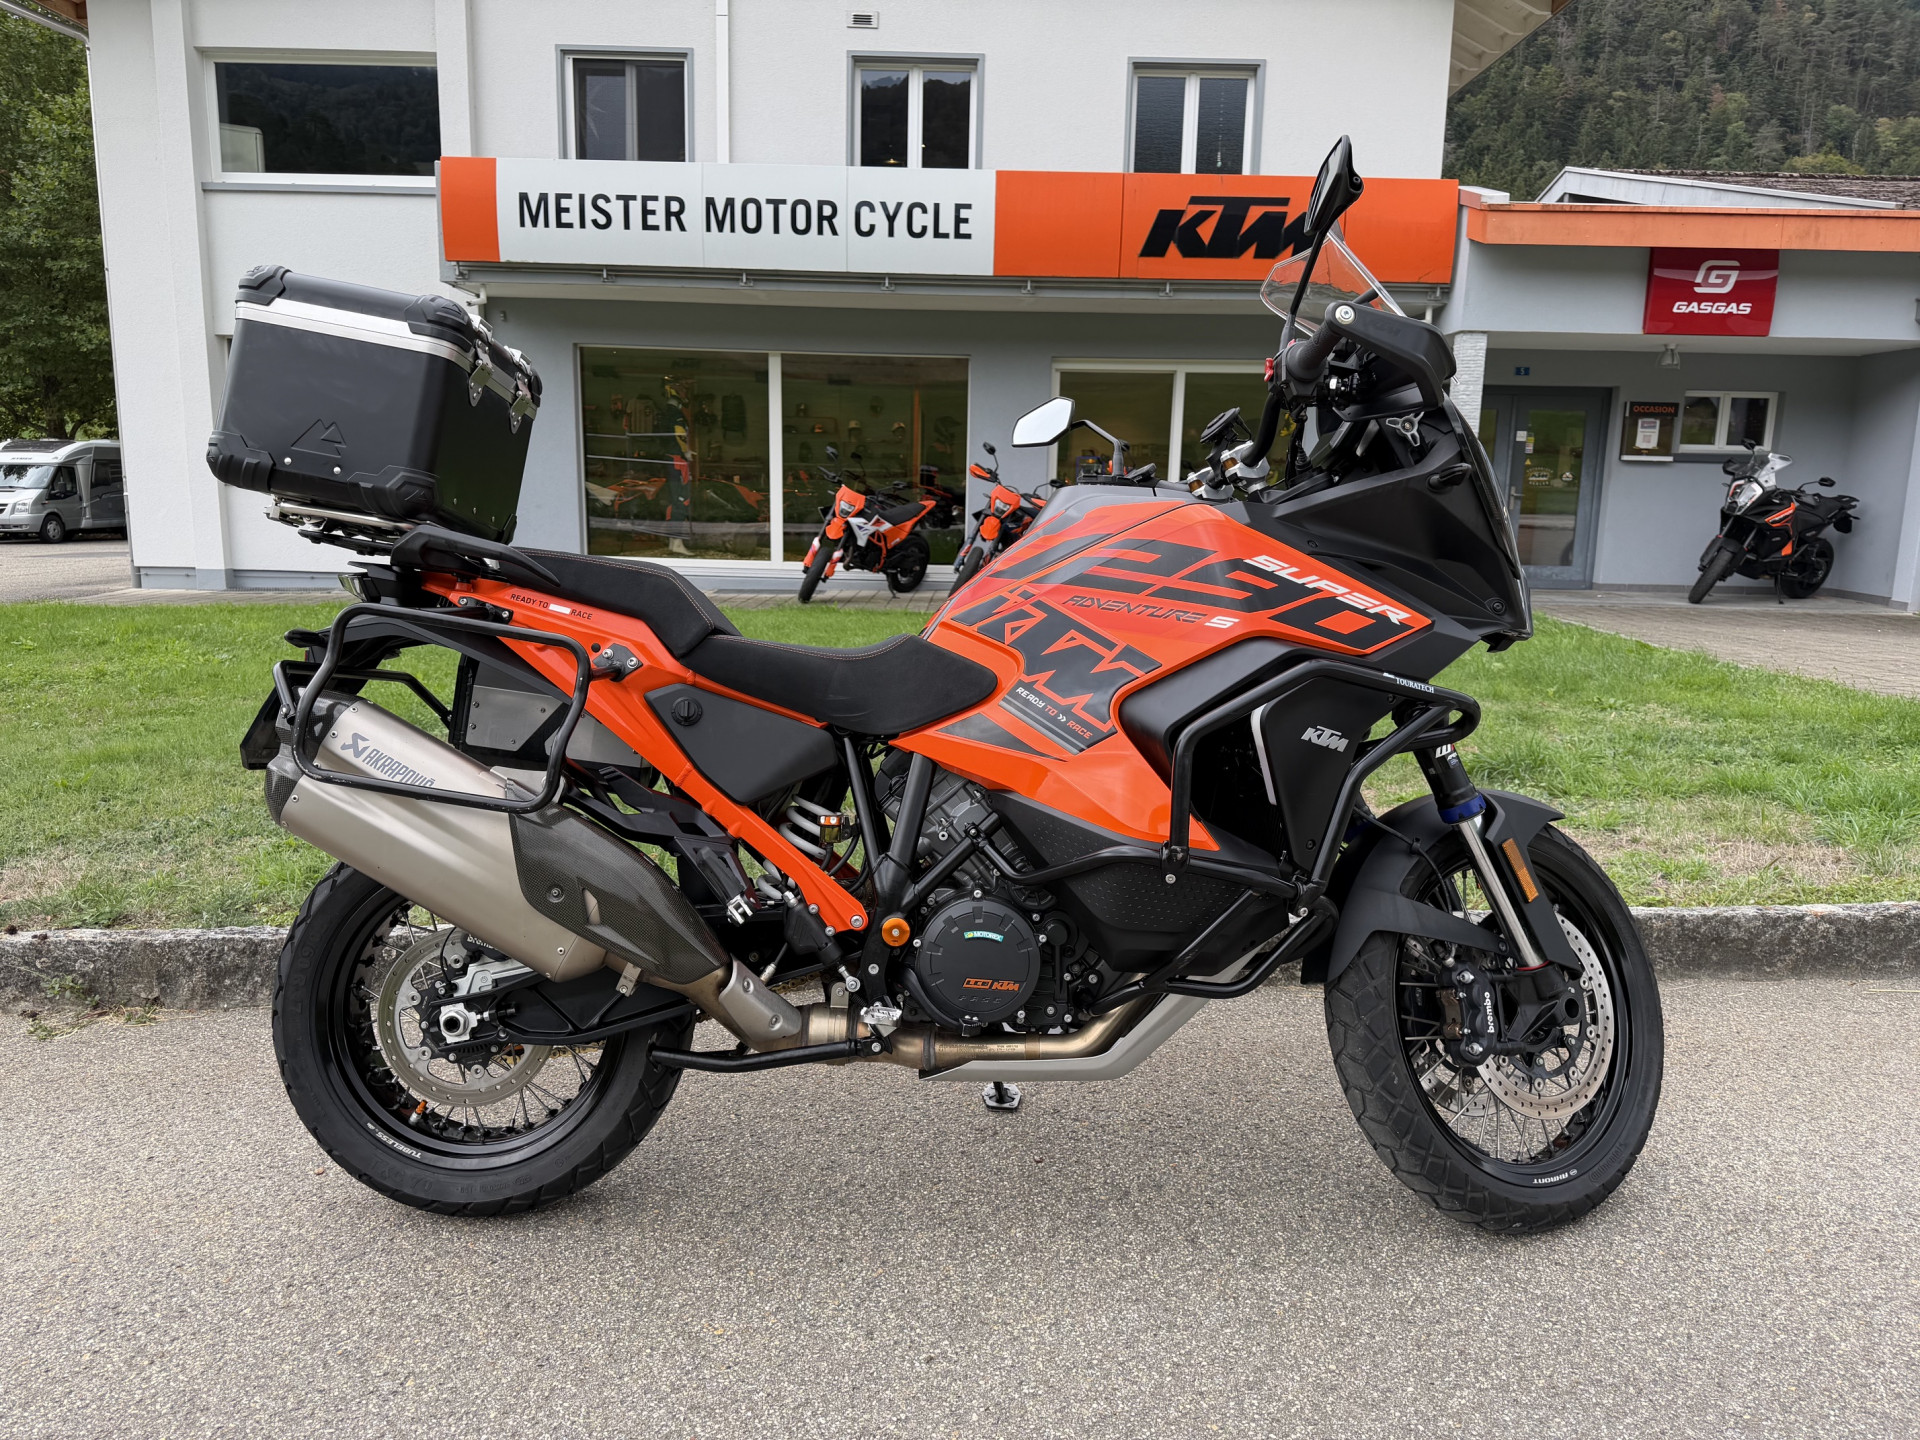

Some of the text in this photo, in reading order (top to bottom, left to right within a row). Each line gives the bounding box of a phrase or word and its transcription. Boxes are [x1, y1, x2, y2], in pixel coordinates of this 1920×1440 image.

[518, 192, 973, 240] MEISTER MOTOR CYCLE
[1137, 196, 1314, 259] KTM
[1672, 302, 1752, 315] GASGAS
[1633, 405, 1675, 413] OCCASION
[1244, 555, 1416, 625] SUPER
[511, 594, 593, 620] READY TO RACE
[1062, 596, 1240, 628] ADVENTURE S
[1395, 677, 1435, 693] TOURATECH
[1015, 687, 1093, 739] READY TO RACE
[1300, 725, 1350, 753] KTM
[992, 980, 1019, 991] KTM
[1483, 991, 1495, 1033] brembo
[375, 1131, 422, 1159] TUBELESS
